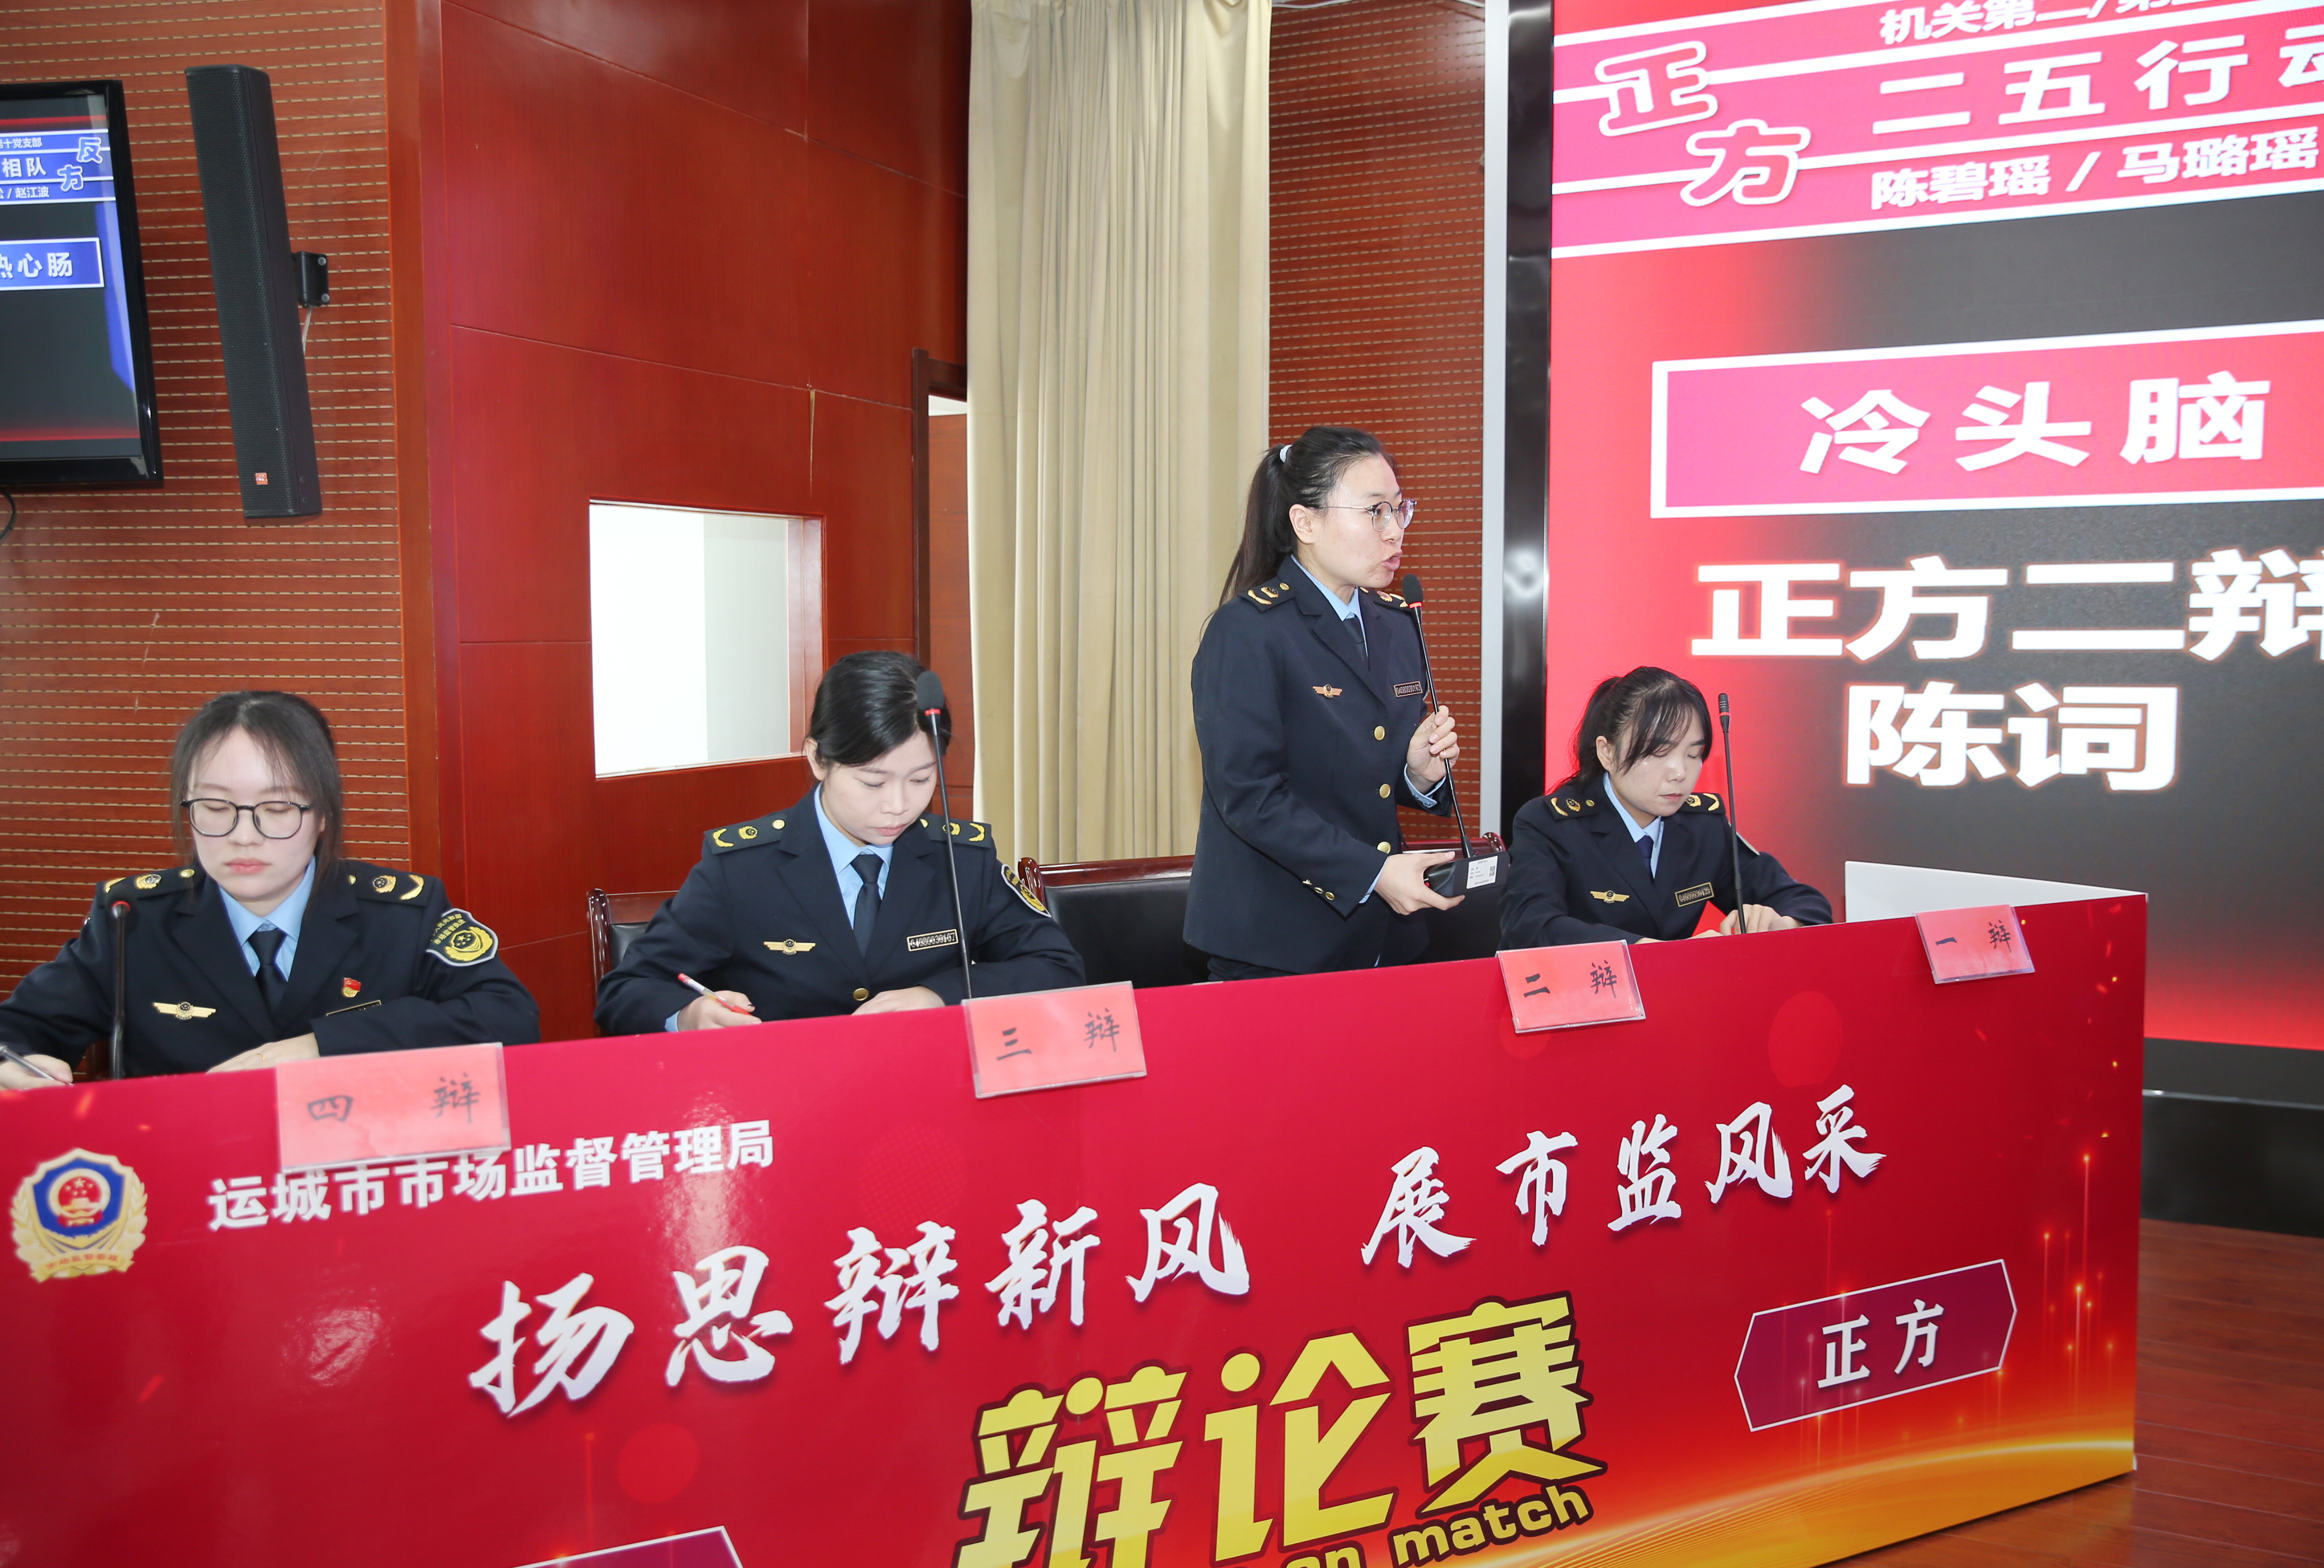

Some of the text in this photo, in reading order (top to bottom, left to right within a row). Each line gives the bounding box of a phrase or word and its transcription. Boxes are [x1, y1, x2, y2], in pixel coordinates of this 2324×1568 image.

[2, 157, 46, 178] 相队
[57, 137, 103, 192] 反方
[1594, 40, 1811, 207] 正方
[1871, 155, 2050, 210] 陈碧瑶
[2117, 126, 2319, 184] 马璐瑶
[15, 186, 50, 199] 赵江波
[1799, 371, 2270, 475] 冷头脑
[1691, 548, 2324, 661] 正方二辩
[1846, 681, 2178, 791] 陈词
[433, 914, 463, 936] 人民共和国
[208, 1120, 773, 1231] 运城市市场监督管理局
[470, 1084, 1886, 1418] 扬思辩新风 展市监风采
[1818, 1300, 1944, 1389] 正方
[956, 1297, 1604, 1568] 辩论赛
[1393, 1485, 1589, 1566] match
